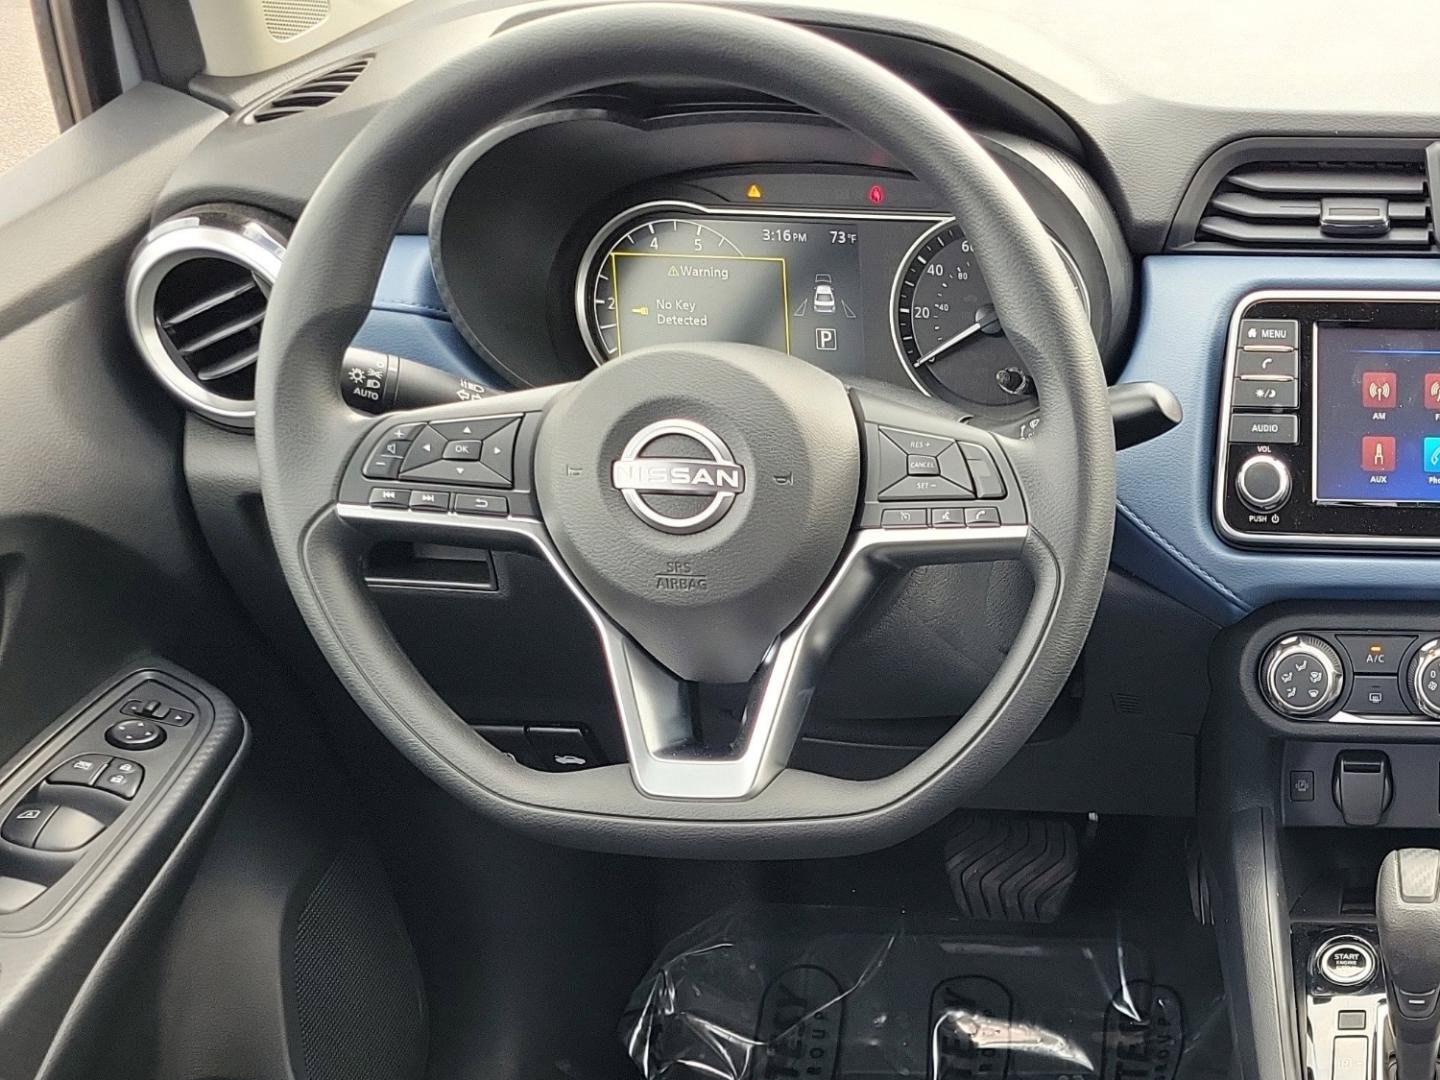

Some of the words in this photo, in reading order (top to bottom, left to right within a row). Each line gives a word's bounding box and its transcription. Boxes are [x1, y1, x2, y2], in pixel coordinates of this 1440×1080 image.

[962, 241, 974, 252] 6
[680, 266, 729, 280] Warning
[927, 264, 943, 276] 40
[656, 300, 673, 309] No
[675, 300, 695, 312] Key
[914, 307, 930, 318] 20
[657, 314, 708, 326] Detected
[1261, 329, 1287, 339] MENU
[353, 387, 379, 400] AUTO
[1372, 412, 1386, 421] AM
[1251, 424, 1279, 433] AUDIO
[455, 445, 470, 454] OK
[617, 466, 739, 488] NISSAN
[1370, 475, 1387, 484] AUX
[1249, 515, 1268, 523] PUSH
[666, 562, 692, 573] SRS
[656, 578, 708, 591] AIRBAG
[1366, 654, 1385, 663] A/C
